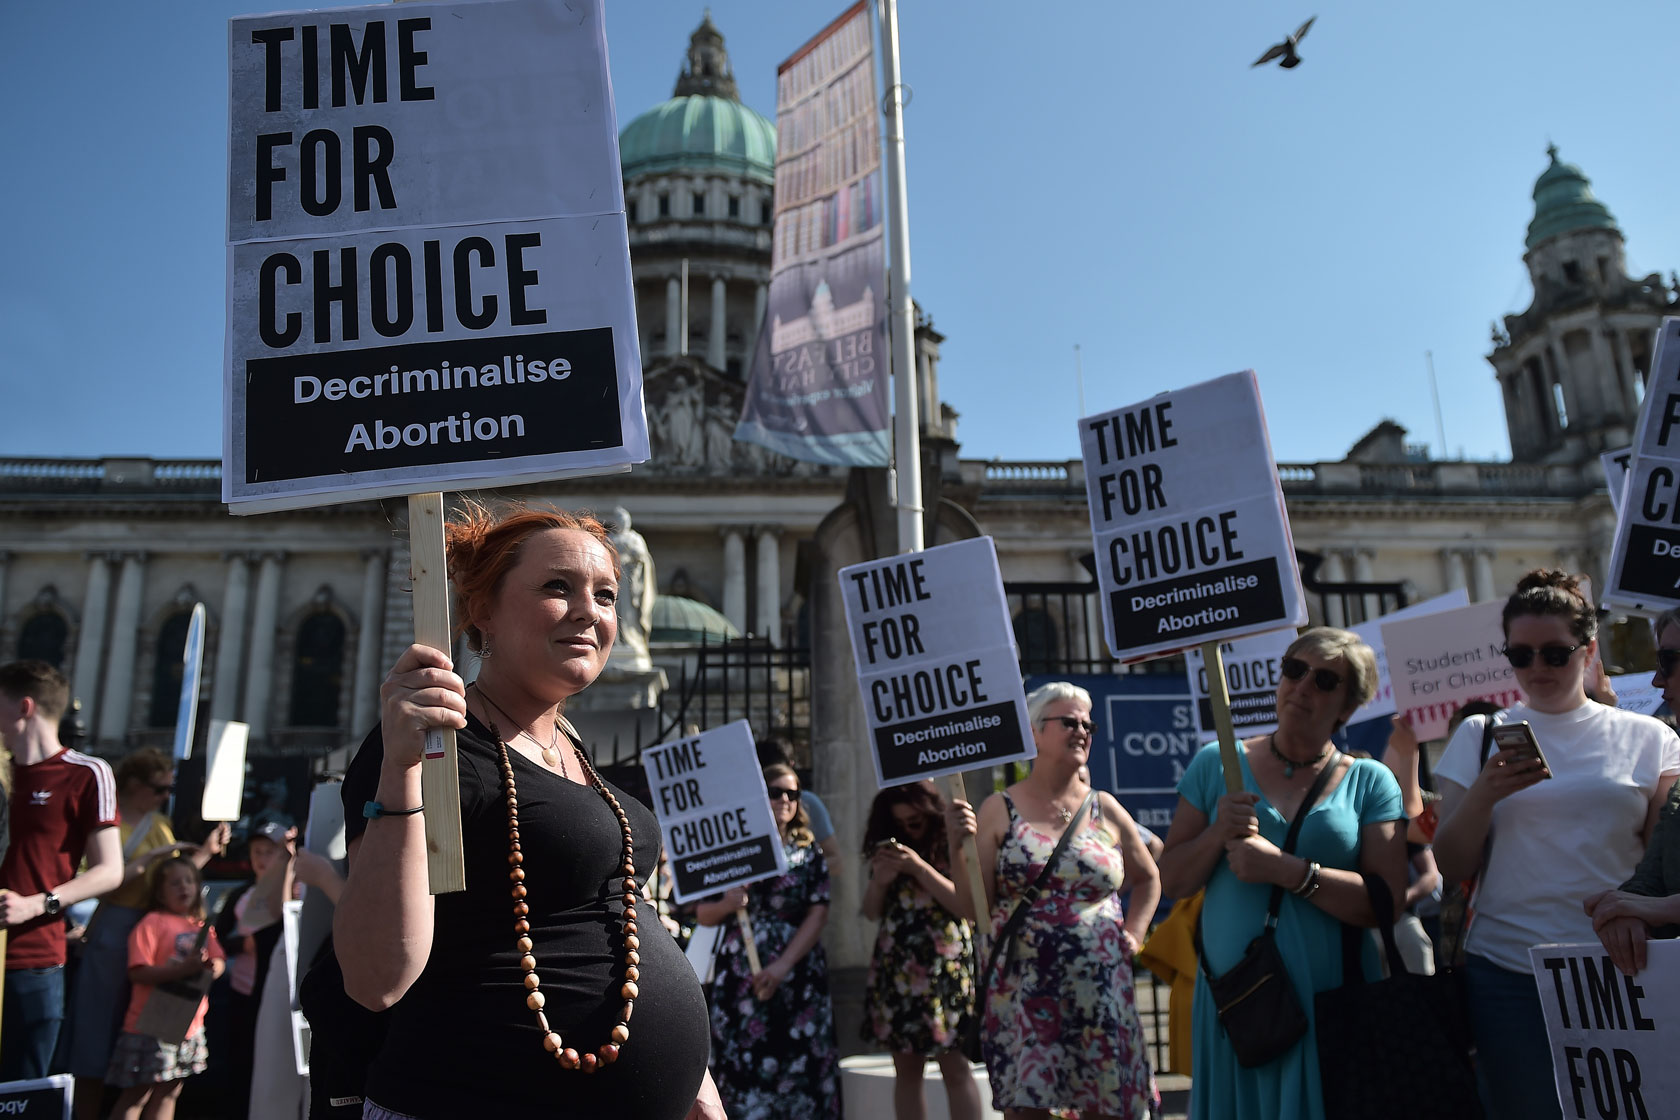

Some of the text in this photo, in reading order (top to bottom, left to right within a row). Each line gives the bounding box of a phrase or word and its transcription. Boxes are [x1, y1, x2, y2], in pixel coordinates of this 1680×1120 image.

[251, 17, 436, 113] TIME
[255, 125, 398, 222] FOR
[258, 232, 548, 349] CHOICE
[293, 353, 572, 405] Decriminalise
[344, 410, 526, 454] Abortion
[1089, 401, 1178, 465] TIME
[1099, 463, 1168, 522] FOR
[1642, 466, 1680, 523] C
[1109, 510, 1244, 586] CHOICE
[850, 558, 931, 613] TIME
[1131, 572, 1259, 612] Decriminalise
[862, 613, 925, 665] FOR
[1157, 604, 1240, 634] Abortion
[1198, 658, 1280, 695] COICE
[1406, 646, 1483, 676] Student
[1410, 667, 1514, 695] For Choice
[870, 659, 988, 723] CHOICE
[892, 713, 1002, 747] Decriminalise
[917, 740, 987, 765] Abortion
[650, 740, 707, 780] TIME
[659, 778, 704, 816] FOR
[670, 807, 752, 857] CHOICE
[685, 844, 762, 874] Decriminalise
[702, 863, 753, 886] Abortion
[1543, 956, 1655, 1030] TIME
[1564, 1046, 1650, 1120] FOR
